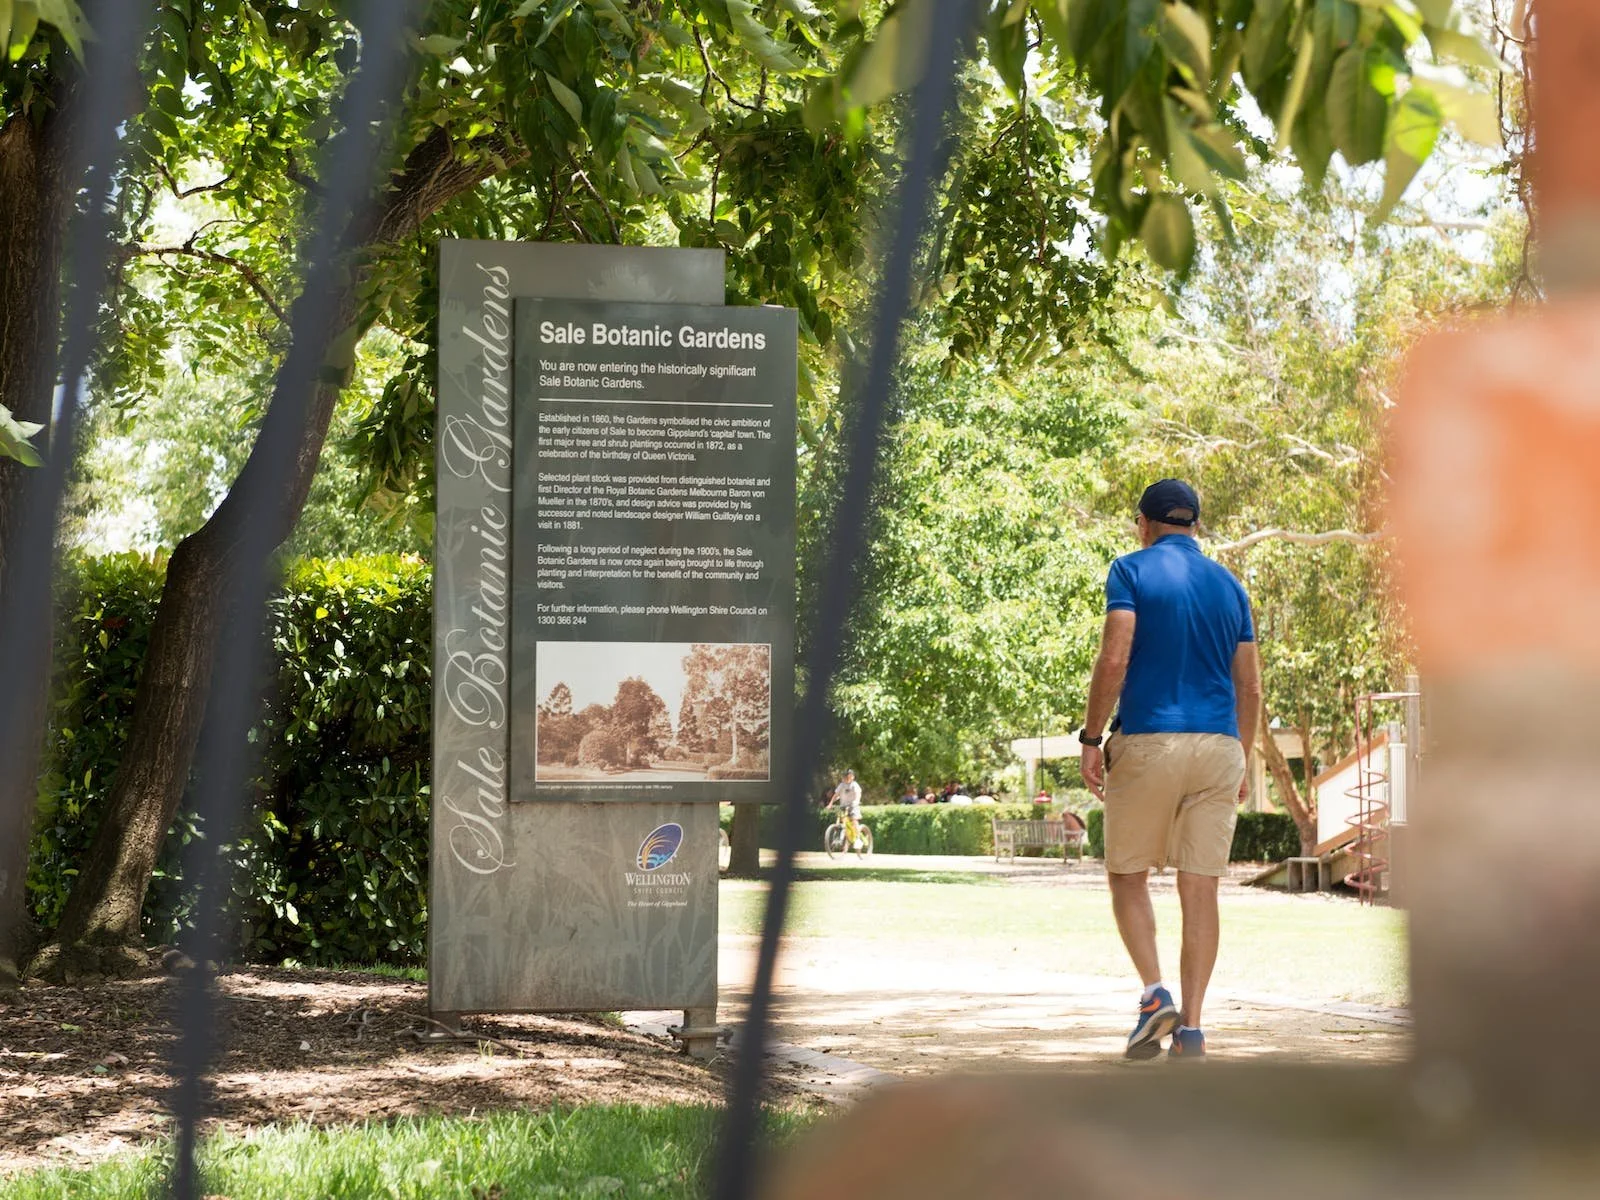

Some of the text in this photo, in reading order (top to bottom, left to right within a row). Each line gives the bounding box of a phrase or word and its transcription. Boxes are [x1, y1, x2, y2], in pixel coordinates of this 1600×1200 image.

[540, 321, 766, 349] Sale Botanic Gardens
[540, 359, 756, 378] You are now entering the historically significant
[540, 375, 644, 388] Sale Botanic Gardens.
[539, 413, 581, 423] Established
[582, 414, 590, 423] in
[612, 414, 625, 424] the
[626, 415, 658, 424] Gardens
[659, 415, 700, 427] symbolised
[701, 416, 712, 425] the
[714, 416, 730, 426] civic
[731, 417, 762, 426] ambition
[763, 417, 771, 426] of
[539, 425, 551, 434] the
[552, 425, 570, 436] early
[572, 425, 600, 435] citizens
[600, 426, 608, 435] of
[609, 426, 626, 435] Sale
[627, 426, 635, 436] to
[636, 427, 665, 436] become
[757, 429, 771, 438] The
[538, 436, 552, 445] first
[554, 436, 574, 448] major
[576, 437, 591, 446] tree
[592, 437, 606, 446] and
[607, 438, 629, 447] shrub
[630, 438, 663, 450] plantings
[664, 439, 696, 448] occurred
[697, 439, 704, 448] in
[538, 448, 579, 458] celebration
[580, 449, 588, 458] of
[589, 449, 601, 458] the
[602, 449, 631, 461] birthday
[633, 450, 640, 459] of
[641, 450, 666, 462] Queen
[538, 473, 570, 482] Selected
[571, 473, 590, 484] plant
[591, 474, 611, 483] stock
[628, 474, 660, 486] provided
[661, 475, 677, 484] from
[679, 475, 726, 487] distinguished
[727, 476, 755, 485] botanist
[756, 476, 771, 485] and
[538, 484, 552, 494] first
[553, 485, 582, 494] Director
[583, 485, 591, 494] of
[593, 485, 604, 494] the
[606, 485, 627, 497] Royal
[628, 486, 655, 495] Botanic
[657, 486, 688, 496] Gardens
[689, 487, 728, 496] Melbourne
[729, 487, 751, 497] Baron
[538, 496, 565, 506] Mueller
[566, 497, 574, 506] in
[575, 497, 587, 506] the
[616, 497, 630, 506] and
[631, 498, 656, 509] design
[657, 498, 681, 507] advice
[698, 499, 729, 510] provided
[730, 499, 739, 510] by
[740, 499, 752, 508] his
[576, 508, 591, 518] and
[592, 509, 613, 518] noted
[614, 509, 651, 521] landscape
[653, 510, 684, 521] designer
[685, 510, 711, 520] William
[538, 520, 552, 529] visit
[554, 520, 561, 529] in
[538, 544, 572, 555] Following
[580, 544, 596, 556] long
[597, 545, 621, 556] period
[622, 545, 630, 554] of
[631, 545, 657, 556] neglect
[659, 545, 682, 557] during
[683, 546, 695, 555] the
[723, 546, 735, 555] the
[736, 546, 752, 556] Sale
[442, 262, 516, 875] Sale Botanic Gardens
[537, 556, 565, 565] Botanic
[566, 556, 598, 565] Gardens
[599, 556, 606, 565] is
[644, 557, 664, 568] again
[665, 557, 686, 569] being
[686, 558, 715, 569] brought
[716, 558, 723, 567] to
[724, 558, 735, 567] life
[736, 558, 764, 570] through
[537, 567, 759, 581] planting and interpretation for the benefit of the community and
[537, 603, 549, 612] For
[551, 604, 575, 613] further
[620, 604, 645, 616] please
[646, 604, 669, 616] phone
[670, 605, 708, 616] Wellington
[709, 605, 728, 614] Shire
[729, 605, 757, 614] Council
[538, 615, 556, 624] 1300
[573, 615, 586, 624] 244
[624, 872, 691, 886] WELLINGTON
